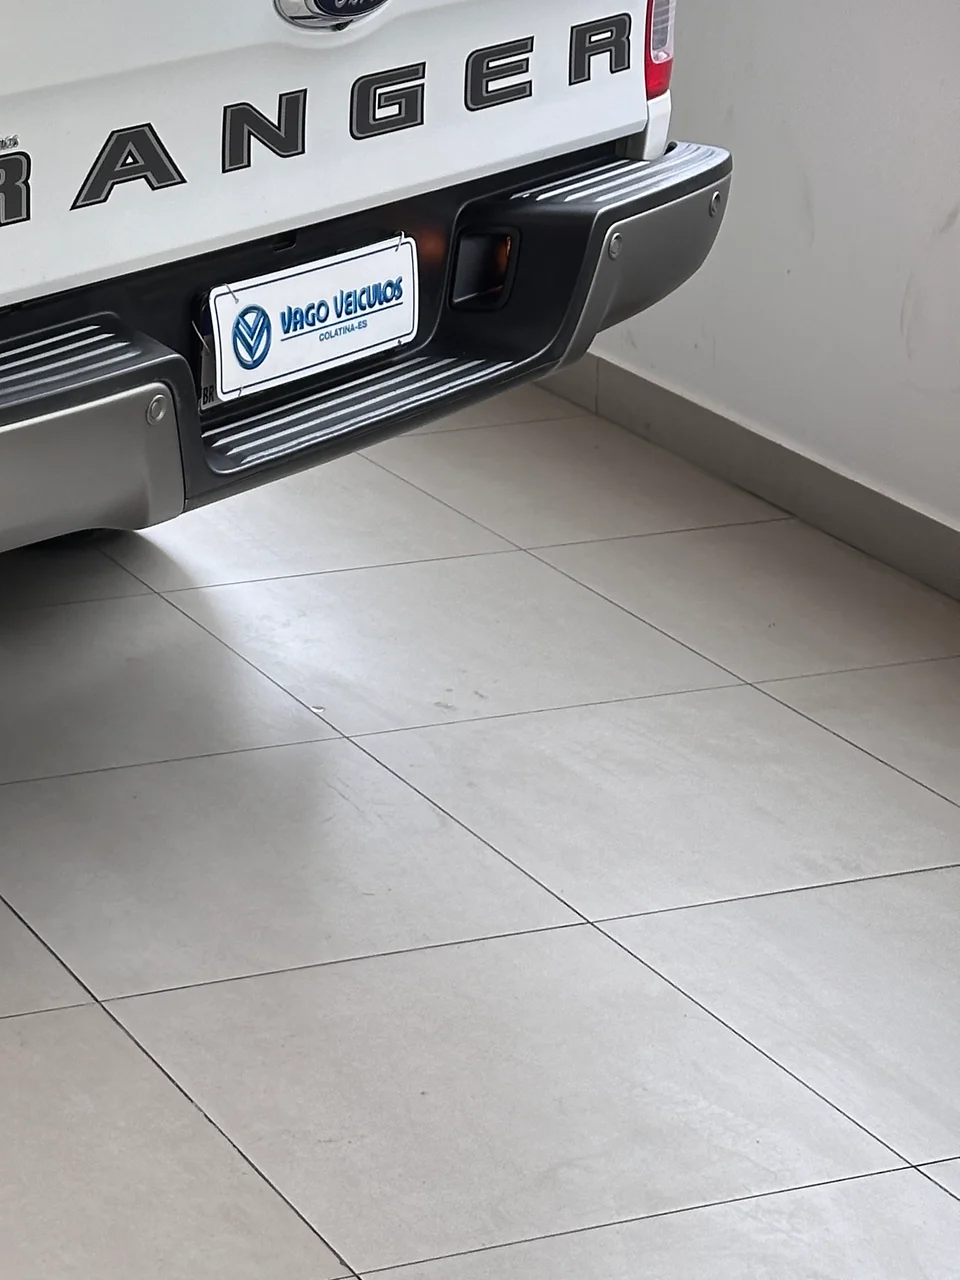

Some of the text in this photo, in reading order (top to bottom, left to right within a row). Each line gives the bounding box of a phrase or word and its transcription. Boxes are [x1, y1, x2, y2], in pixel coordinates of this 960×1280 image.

[280, 275, 403, 335] VAGO VEICULOS
[318, 320, 368, 342] COLATINA-ES
